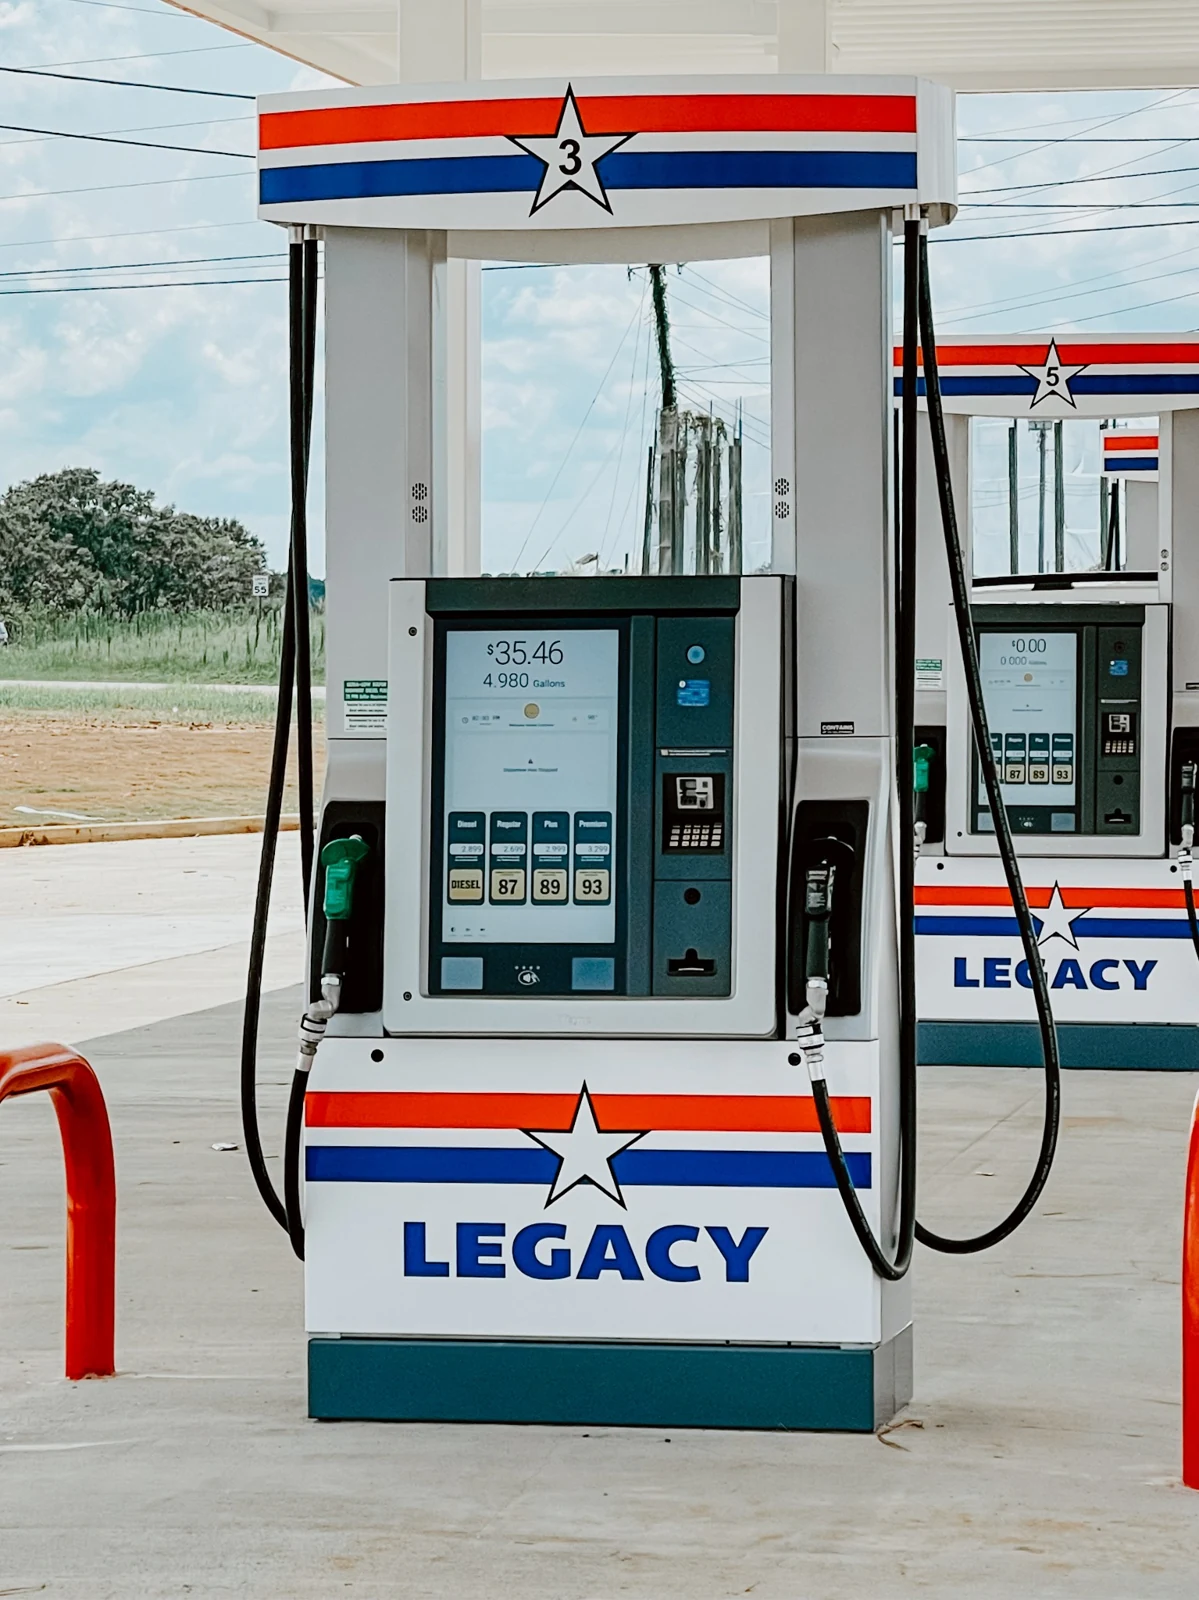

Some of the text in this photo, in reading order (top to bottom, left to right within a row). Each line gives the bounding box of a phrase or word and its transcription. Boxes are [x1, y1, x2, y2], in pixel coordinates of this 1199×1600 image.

[559, 139, 582, 175] 3
[1046, 366, 1059, 386] 5
[254, 586, 267, 594] 55
[487, 640, 564, 665] $35.46
[483, 672, 566, 688] 4.980 Gallons
[1009, 770, 1022, 779] 87
[1033, 770, 1045, 779] 89
[1056, 770, 1069, 780] 93
[451, 880, 481, 889] DIESEL
[498, 879, 518, 895] 87
[540, 879, 561, 895] 89
[582, 879, 603, 895] 93
[404, 1221, 770, 1283] LEGACY
